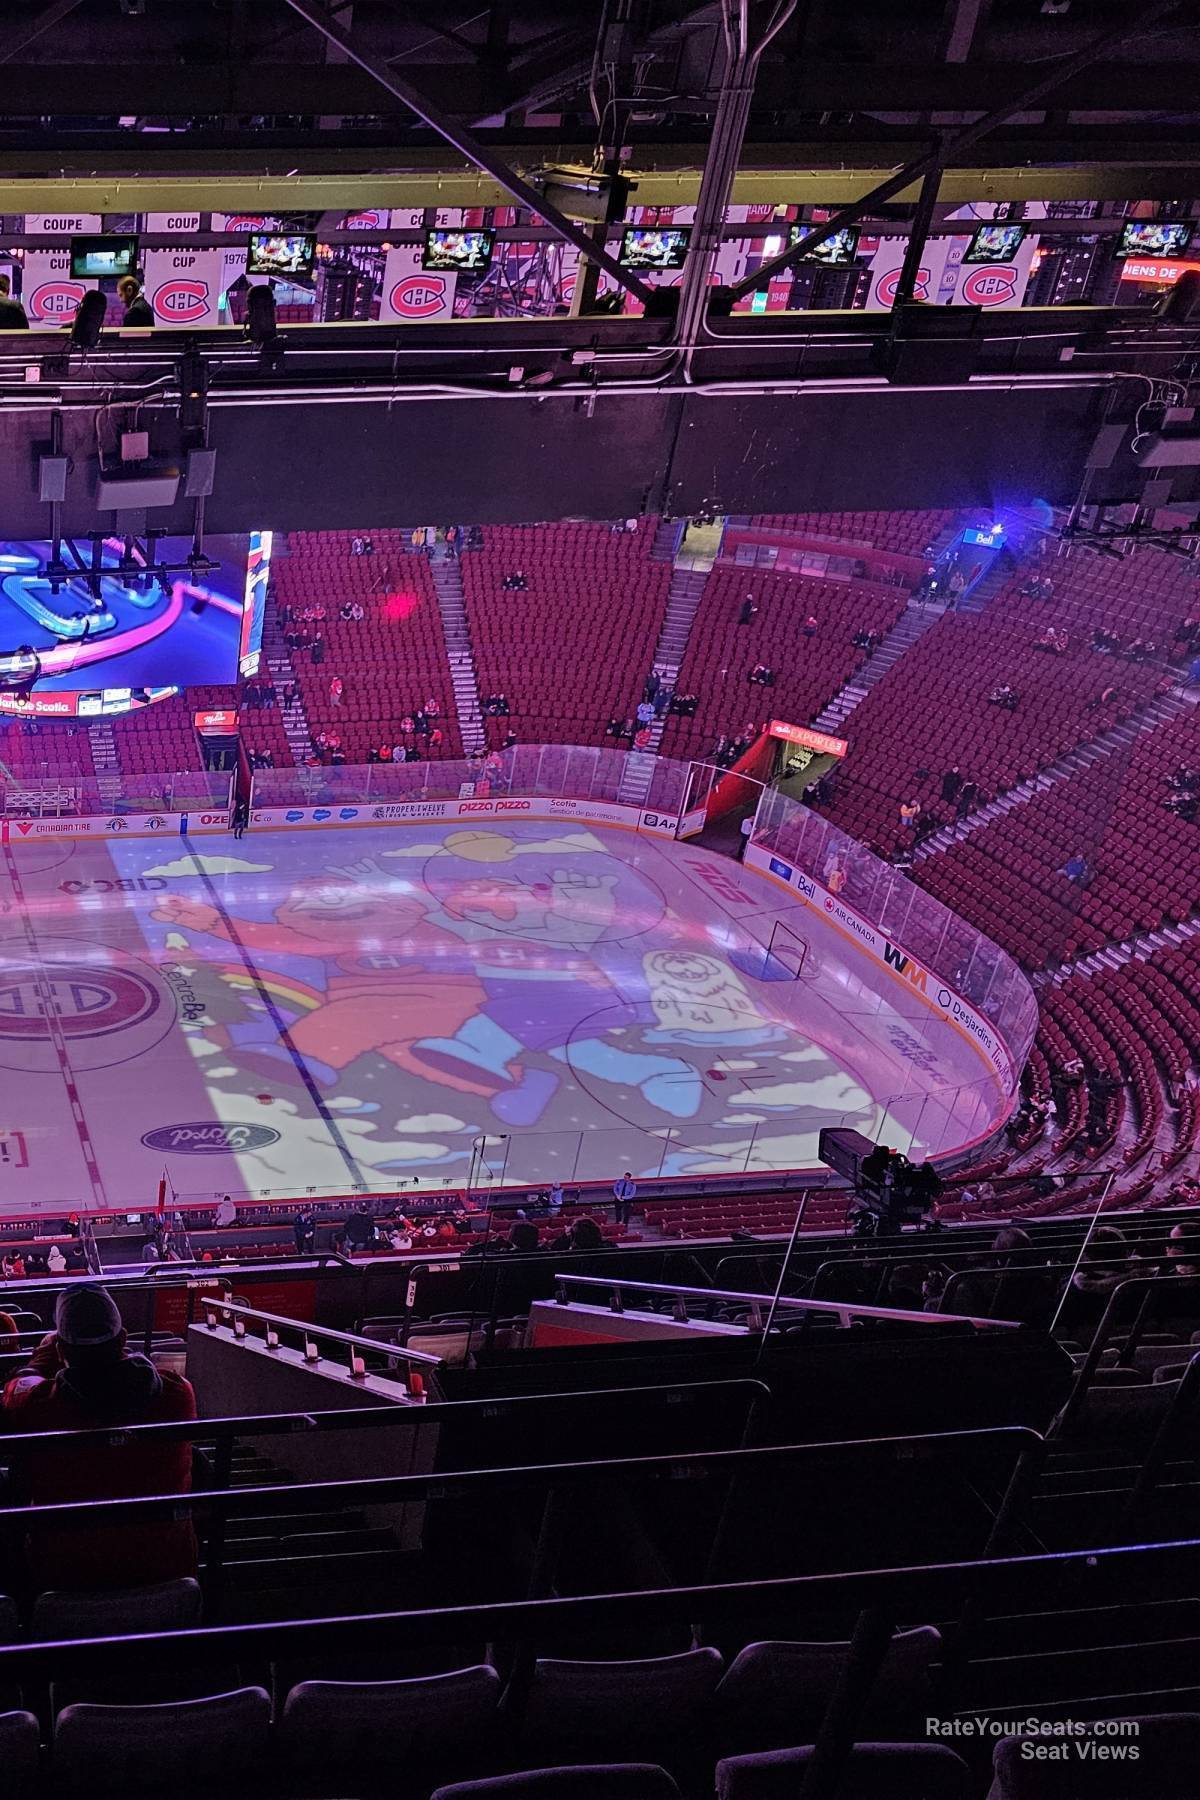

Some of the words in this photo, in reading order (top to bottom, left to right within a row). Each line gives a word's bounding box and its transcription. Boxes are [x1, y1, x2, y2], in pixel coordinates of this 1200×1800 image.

[44, 219, 82, 230] COUPE
[168, 218, 199, 229] COUP
[411, 213, 448, 227] COPE
[173, 257, 196, 268] CUP
[1159, 268, 1178, 279] DE
[976, 533, 994, 545] Bell
[36, 701, 68, 712] Scotia
[458, 801, 493, 814] pizza
[495, 800, 531, 813] pizza
[550, 799, 577, 808] Scotia
[36, 824, 73, 833] CANADIAN
[74, 823, 91, 832] TIRE
[93, 877, 168, 892] CIBC
[798, 875, 816, 899] Bell
[834, 906, 847, 922] AIR
[846, 916, 877, 945] CANADA
[883, 942, 928, 994] WM
[952, 1001, 992, 1050] Desjardins
[170, 1126, 253, 1149] Ford
